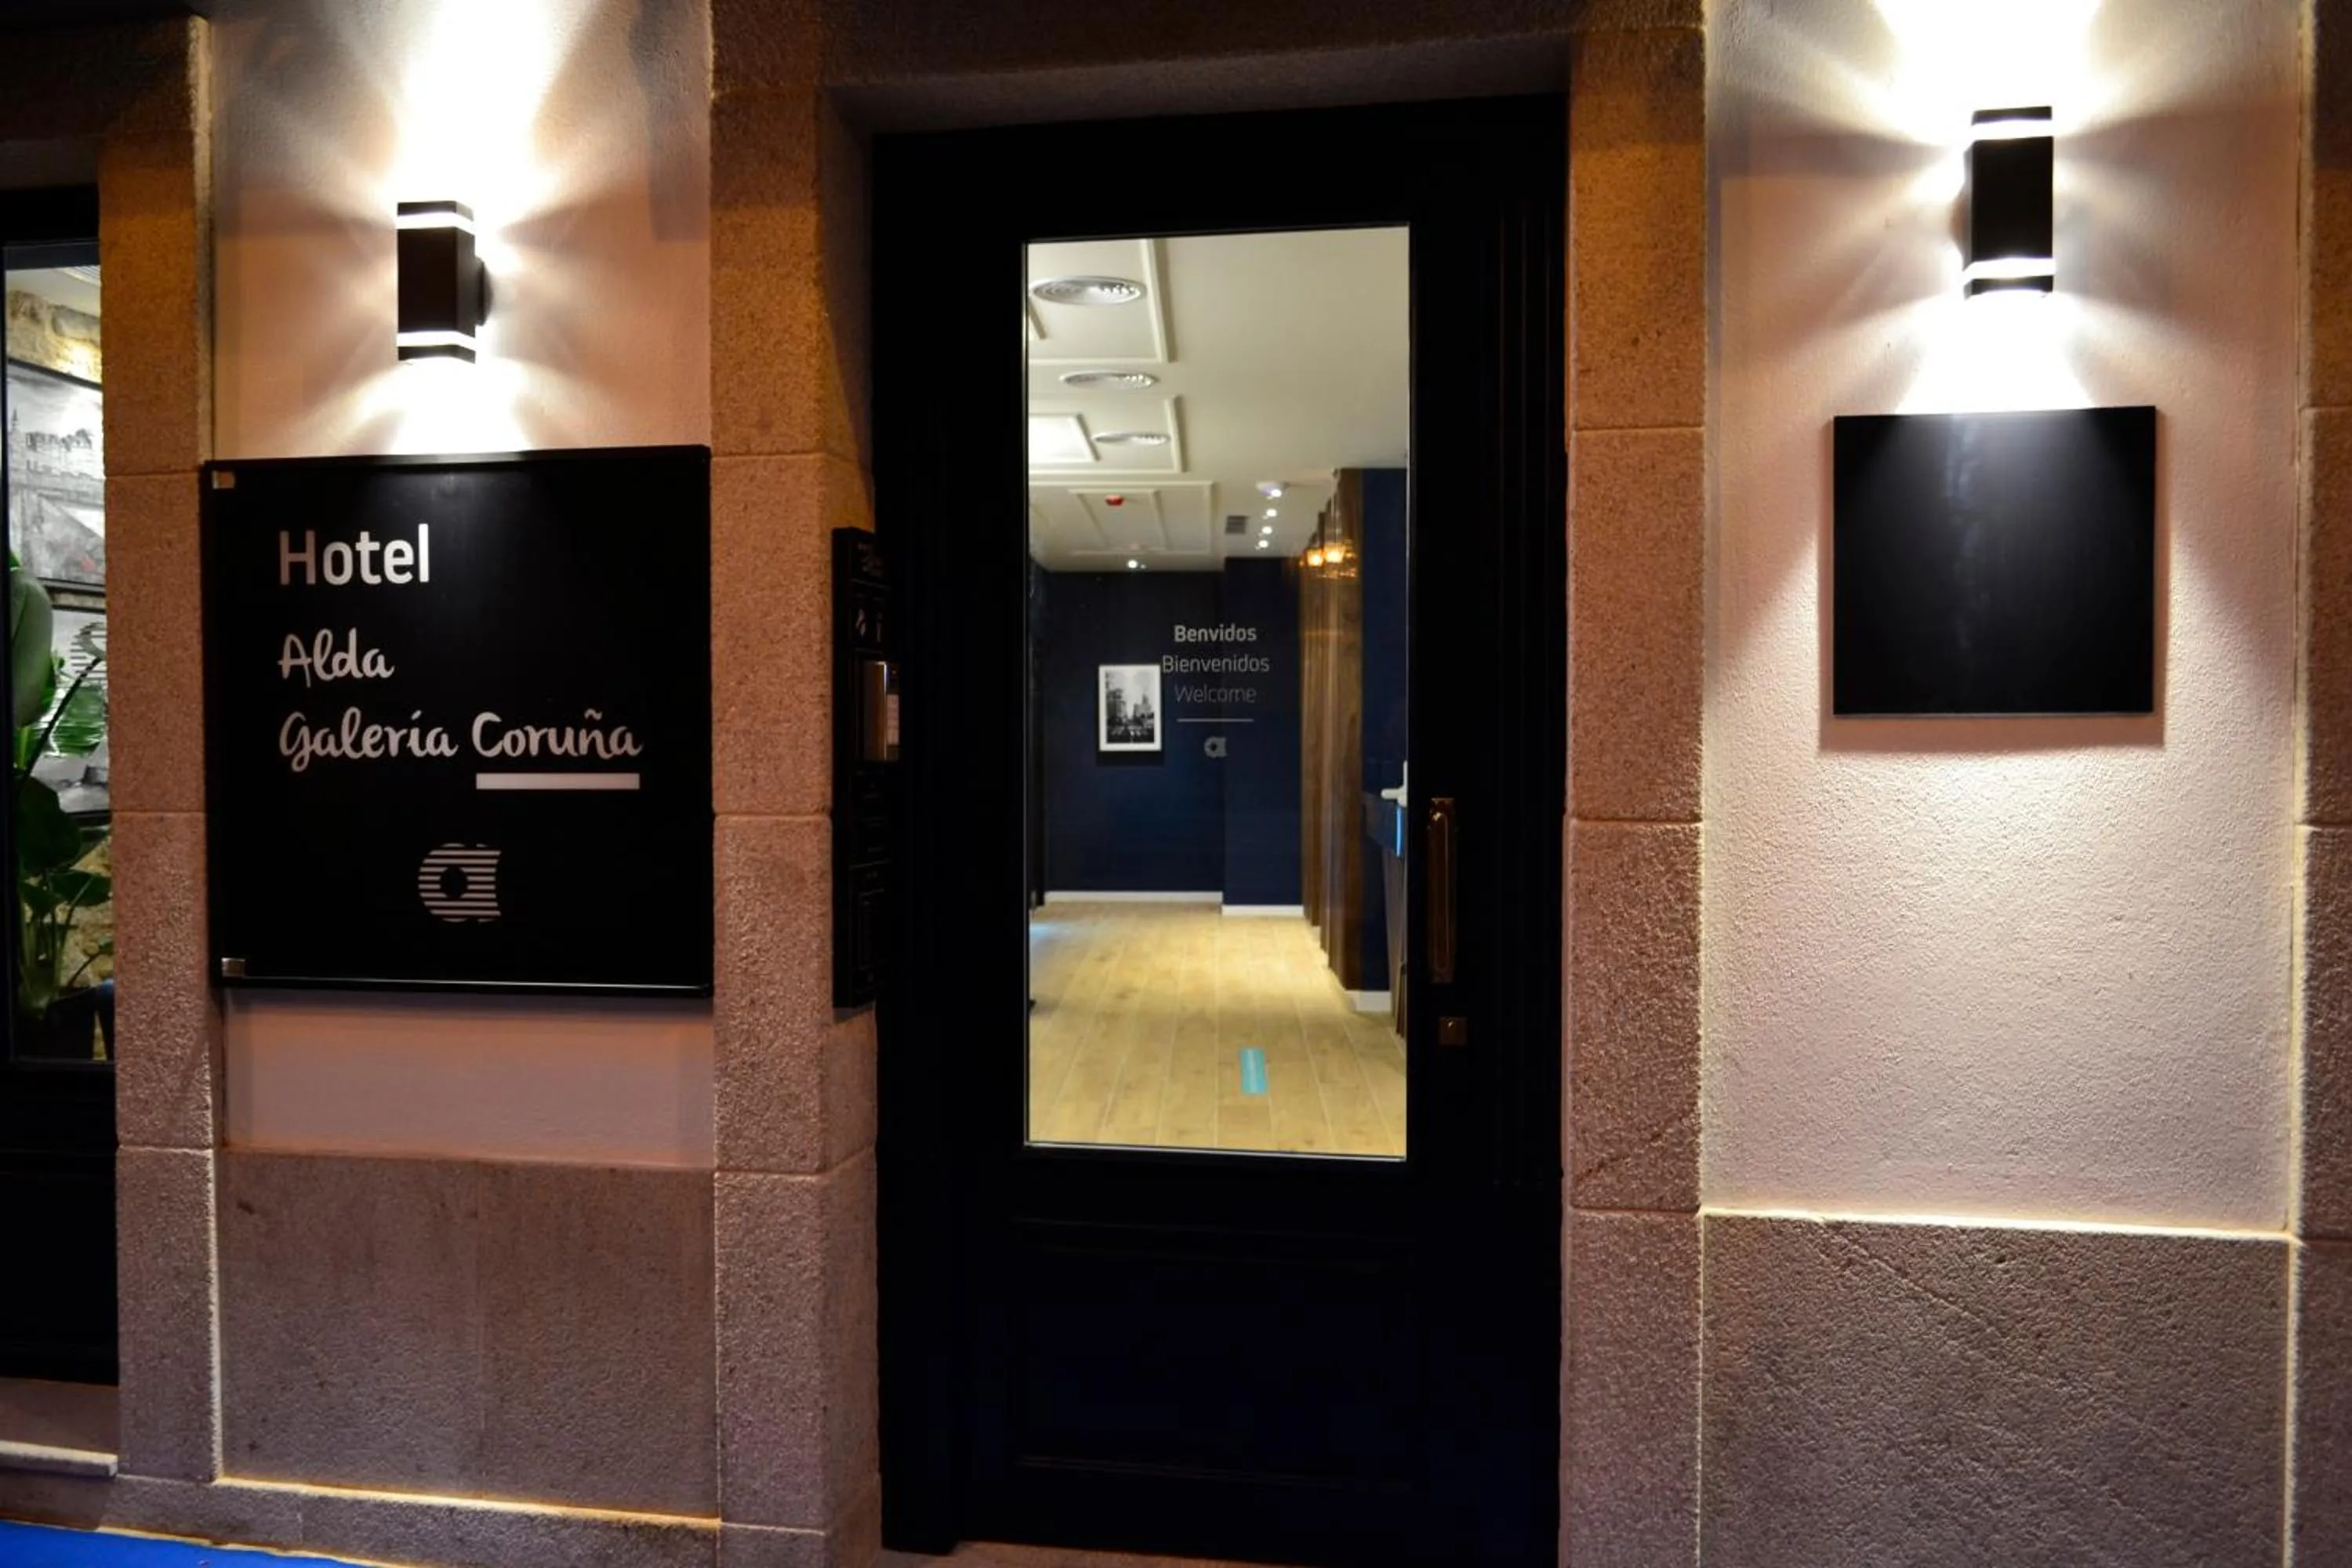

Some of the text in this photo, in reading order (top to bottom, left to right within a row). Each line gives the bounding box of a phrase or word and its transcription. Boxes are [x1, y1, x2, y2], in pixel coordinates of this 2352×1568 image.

[280, 523, 430, 585] Hotel
[1174, 623, 1257, 643] Benvidos
[278, 627, 395, 688] Alda
[1162, 655, 1270, 674] Bienvenidos
[1174, 684, 1258, 703] Welcome
[279, 706, 643, 772] Galería Coruña
